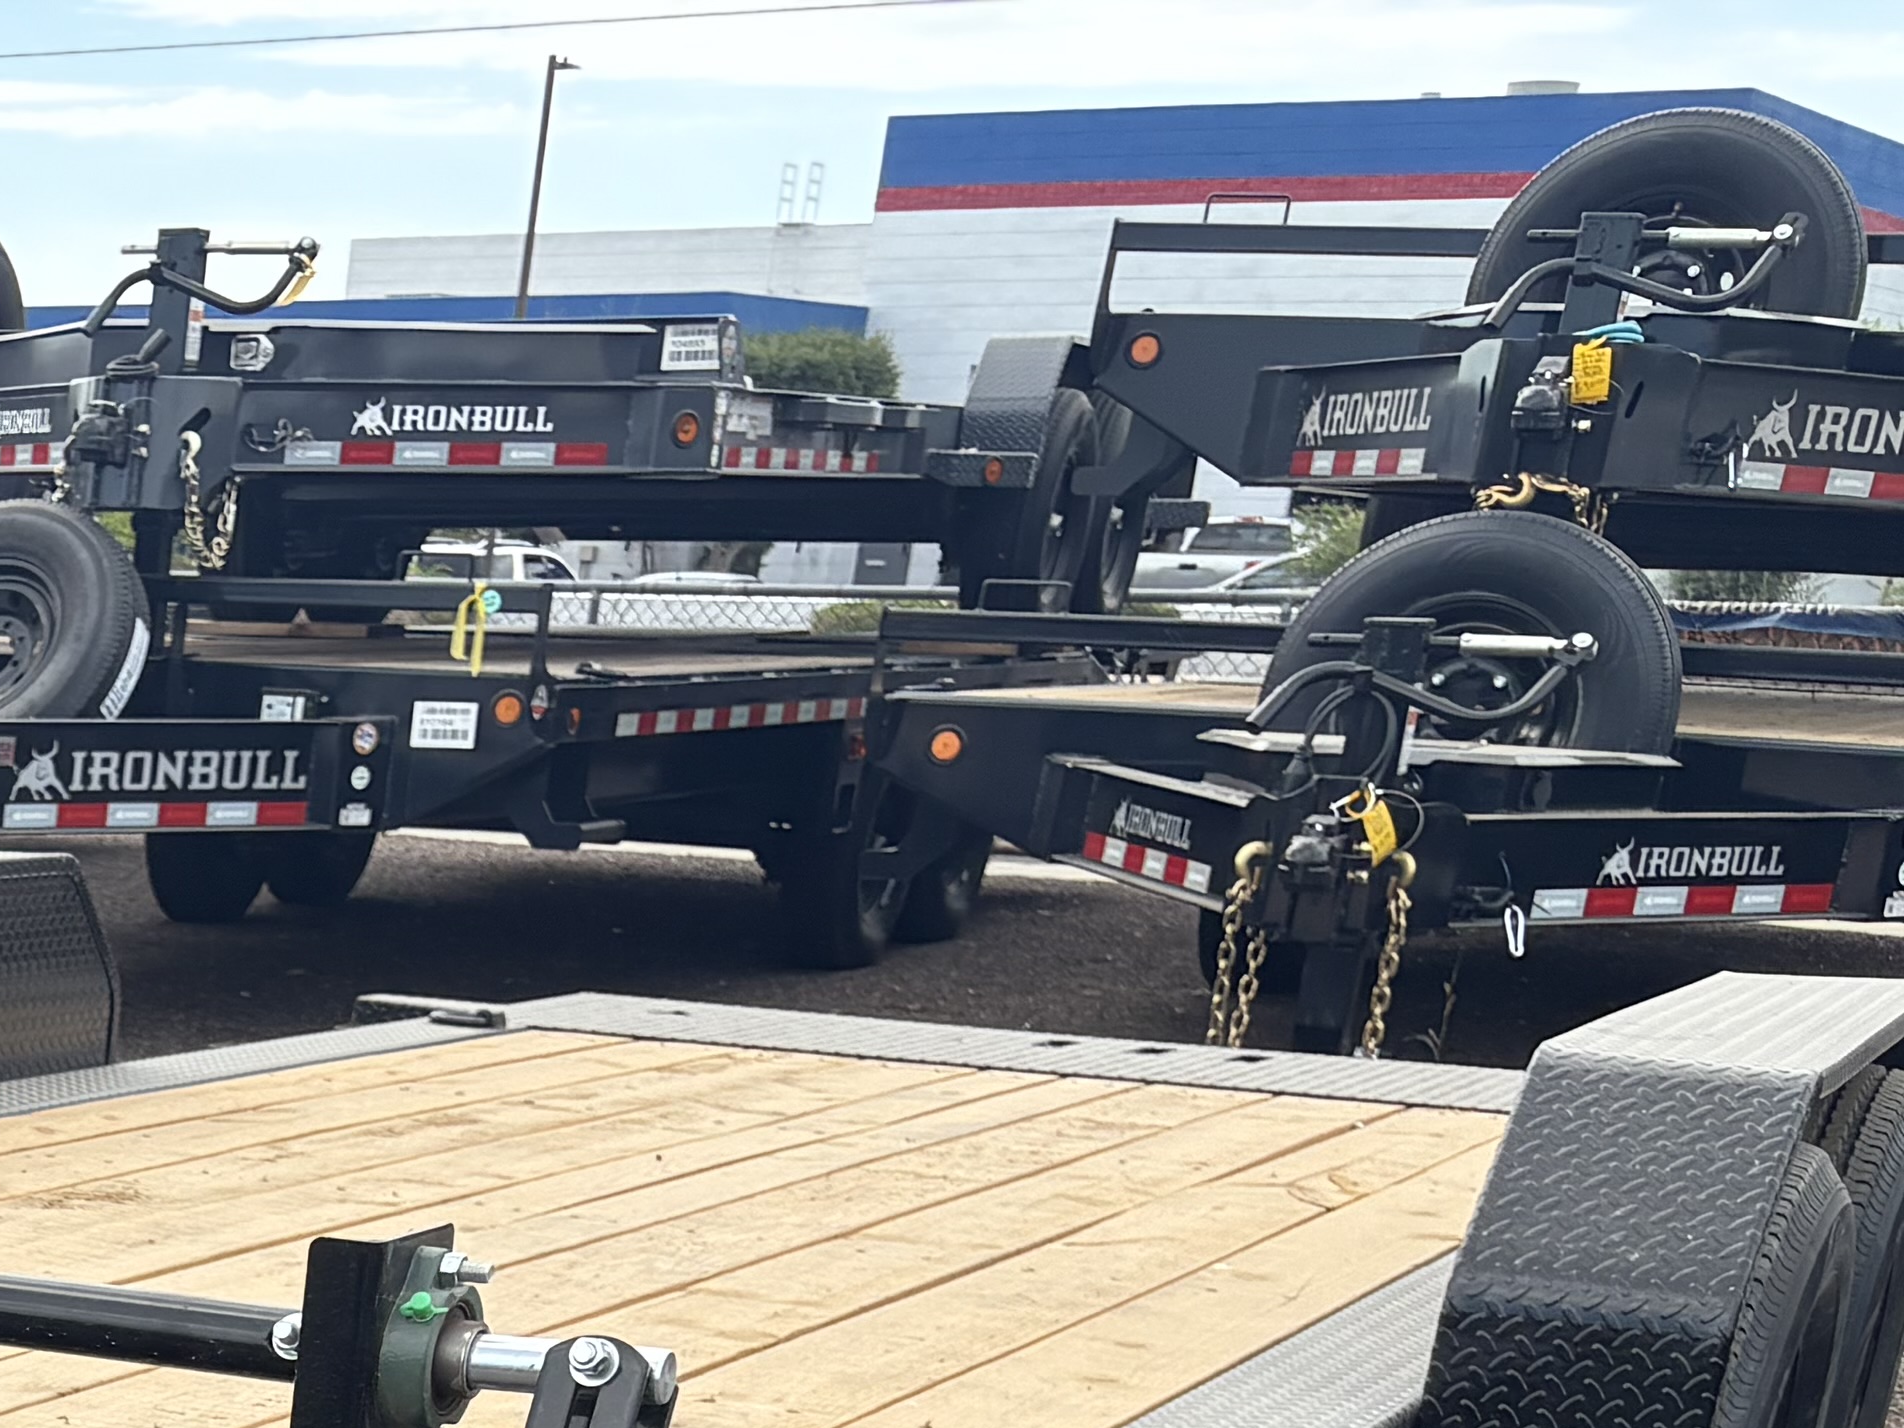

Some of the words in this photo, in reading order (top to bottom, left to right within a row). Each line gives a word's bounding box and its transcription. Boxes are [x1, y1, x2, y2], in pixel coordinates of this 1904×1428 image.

[391, 405, 554, 433] IRONBULL
[1322, 387, 1432, 437] IRONBULL
[69, 750, 307, 791] IRONBULL
[1636, 845, 1785, 878] IRONBULL
